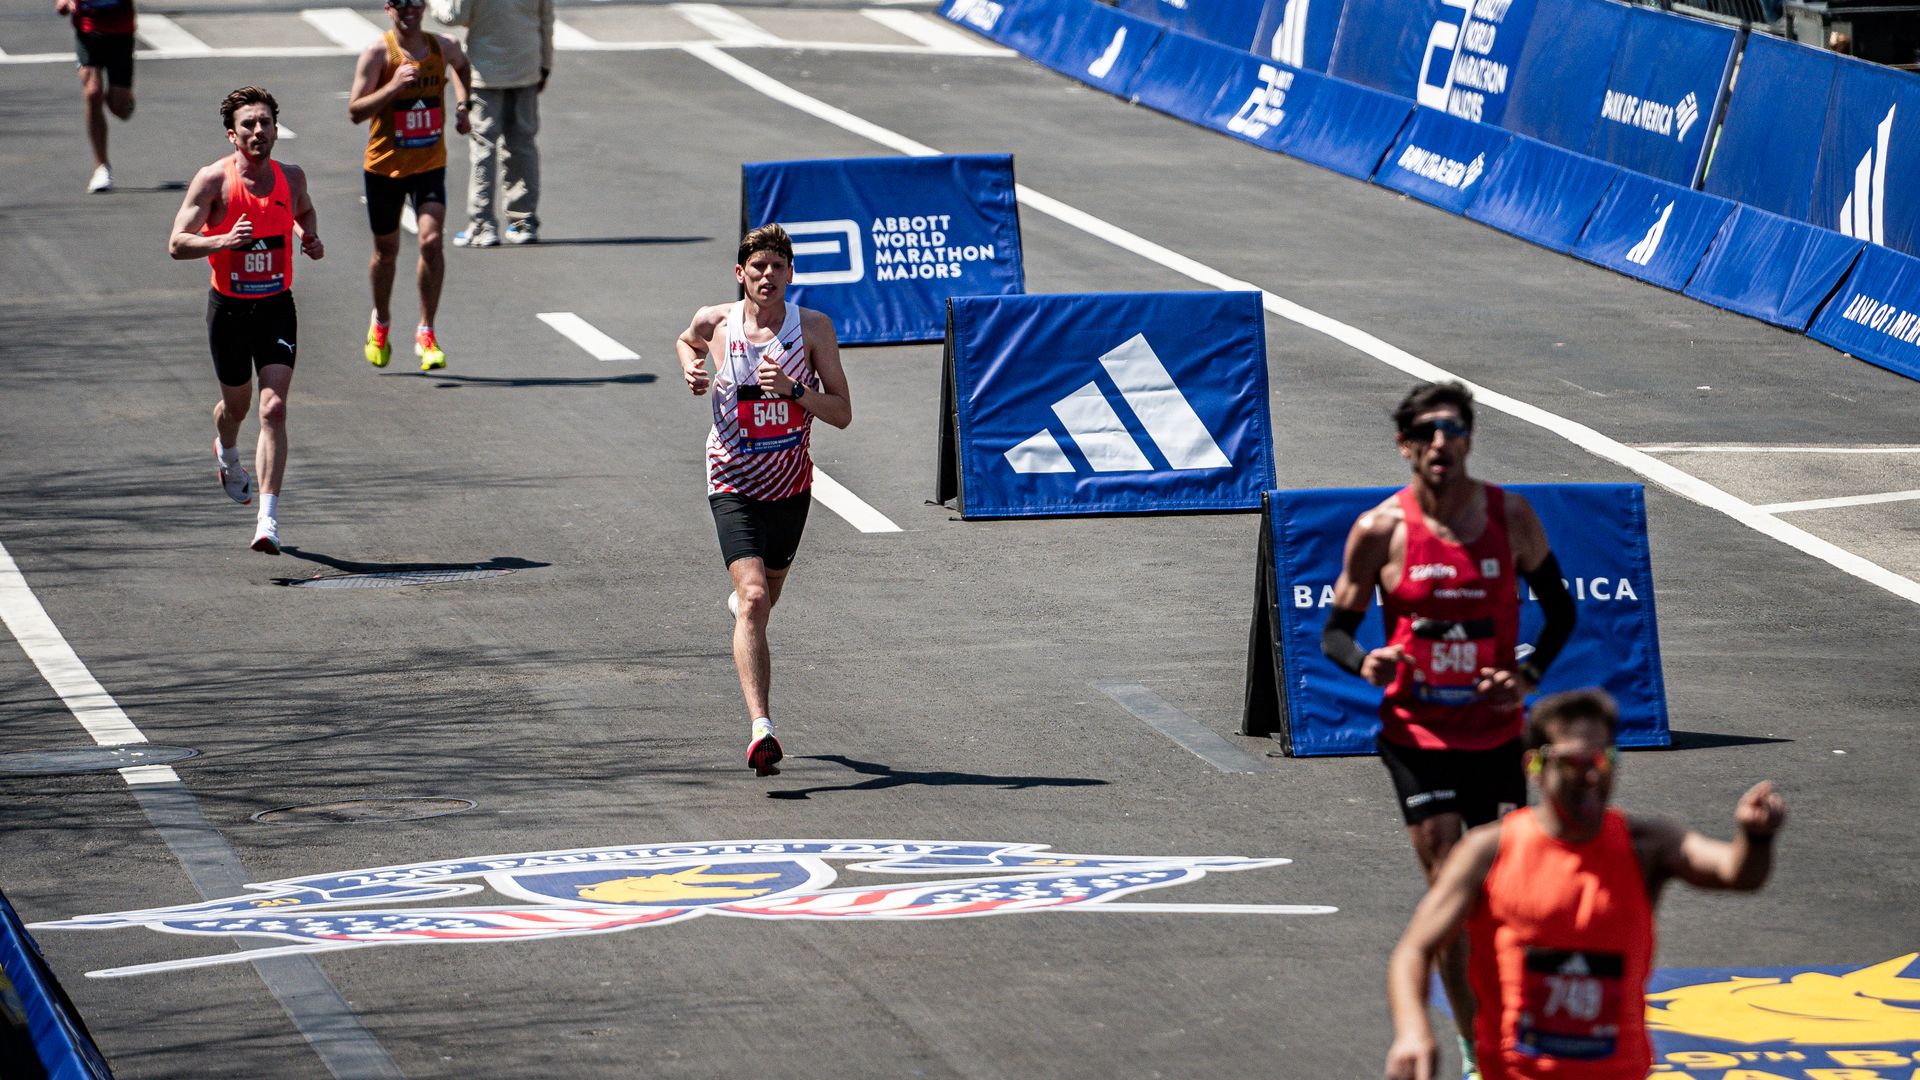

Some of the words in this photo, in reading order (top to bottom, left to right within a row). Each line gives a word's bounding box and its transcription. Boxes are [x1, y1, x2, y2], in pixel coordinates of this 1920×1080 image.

[406, 110, 431, 130] 911
[872, 215, 950, 233] ABBOTT
[873, 231, 946, 248] WORLD
[244, 252, 272, 273] 661
[875, 244, 995, 265] MARATHON
[877, 262, 962, 281] MAJORS
[1869, 303, 1896, 331] OF
[753, 401, 789, 427] 549
[478, 843, 805, 870] PATRIOTS'
[820, 844, 960, 855] DAY
[1650, 1050, 1807, 1070] 9TH
